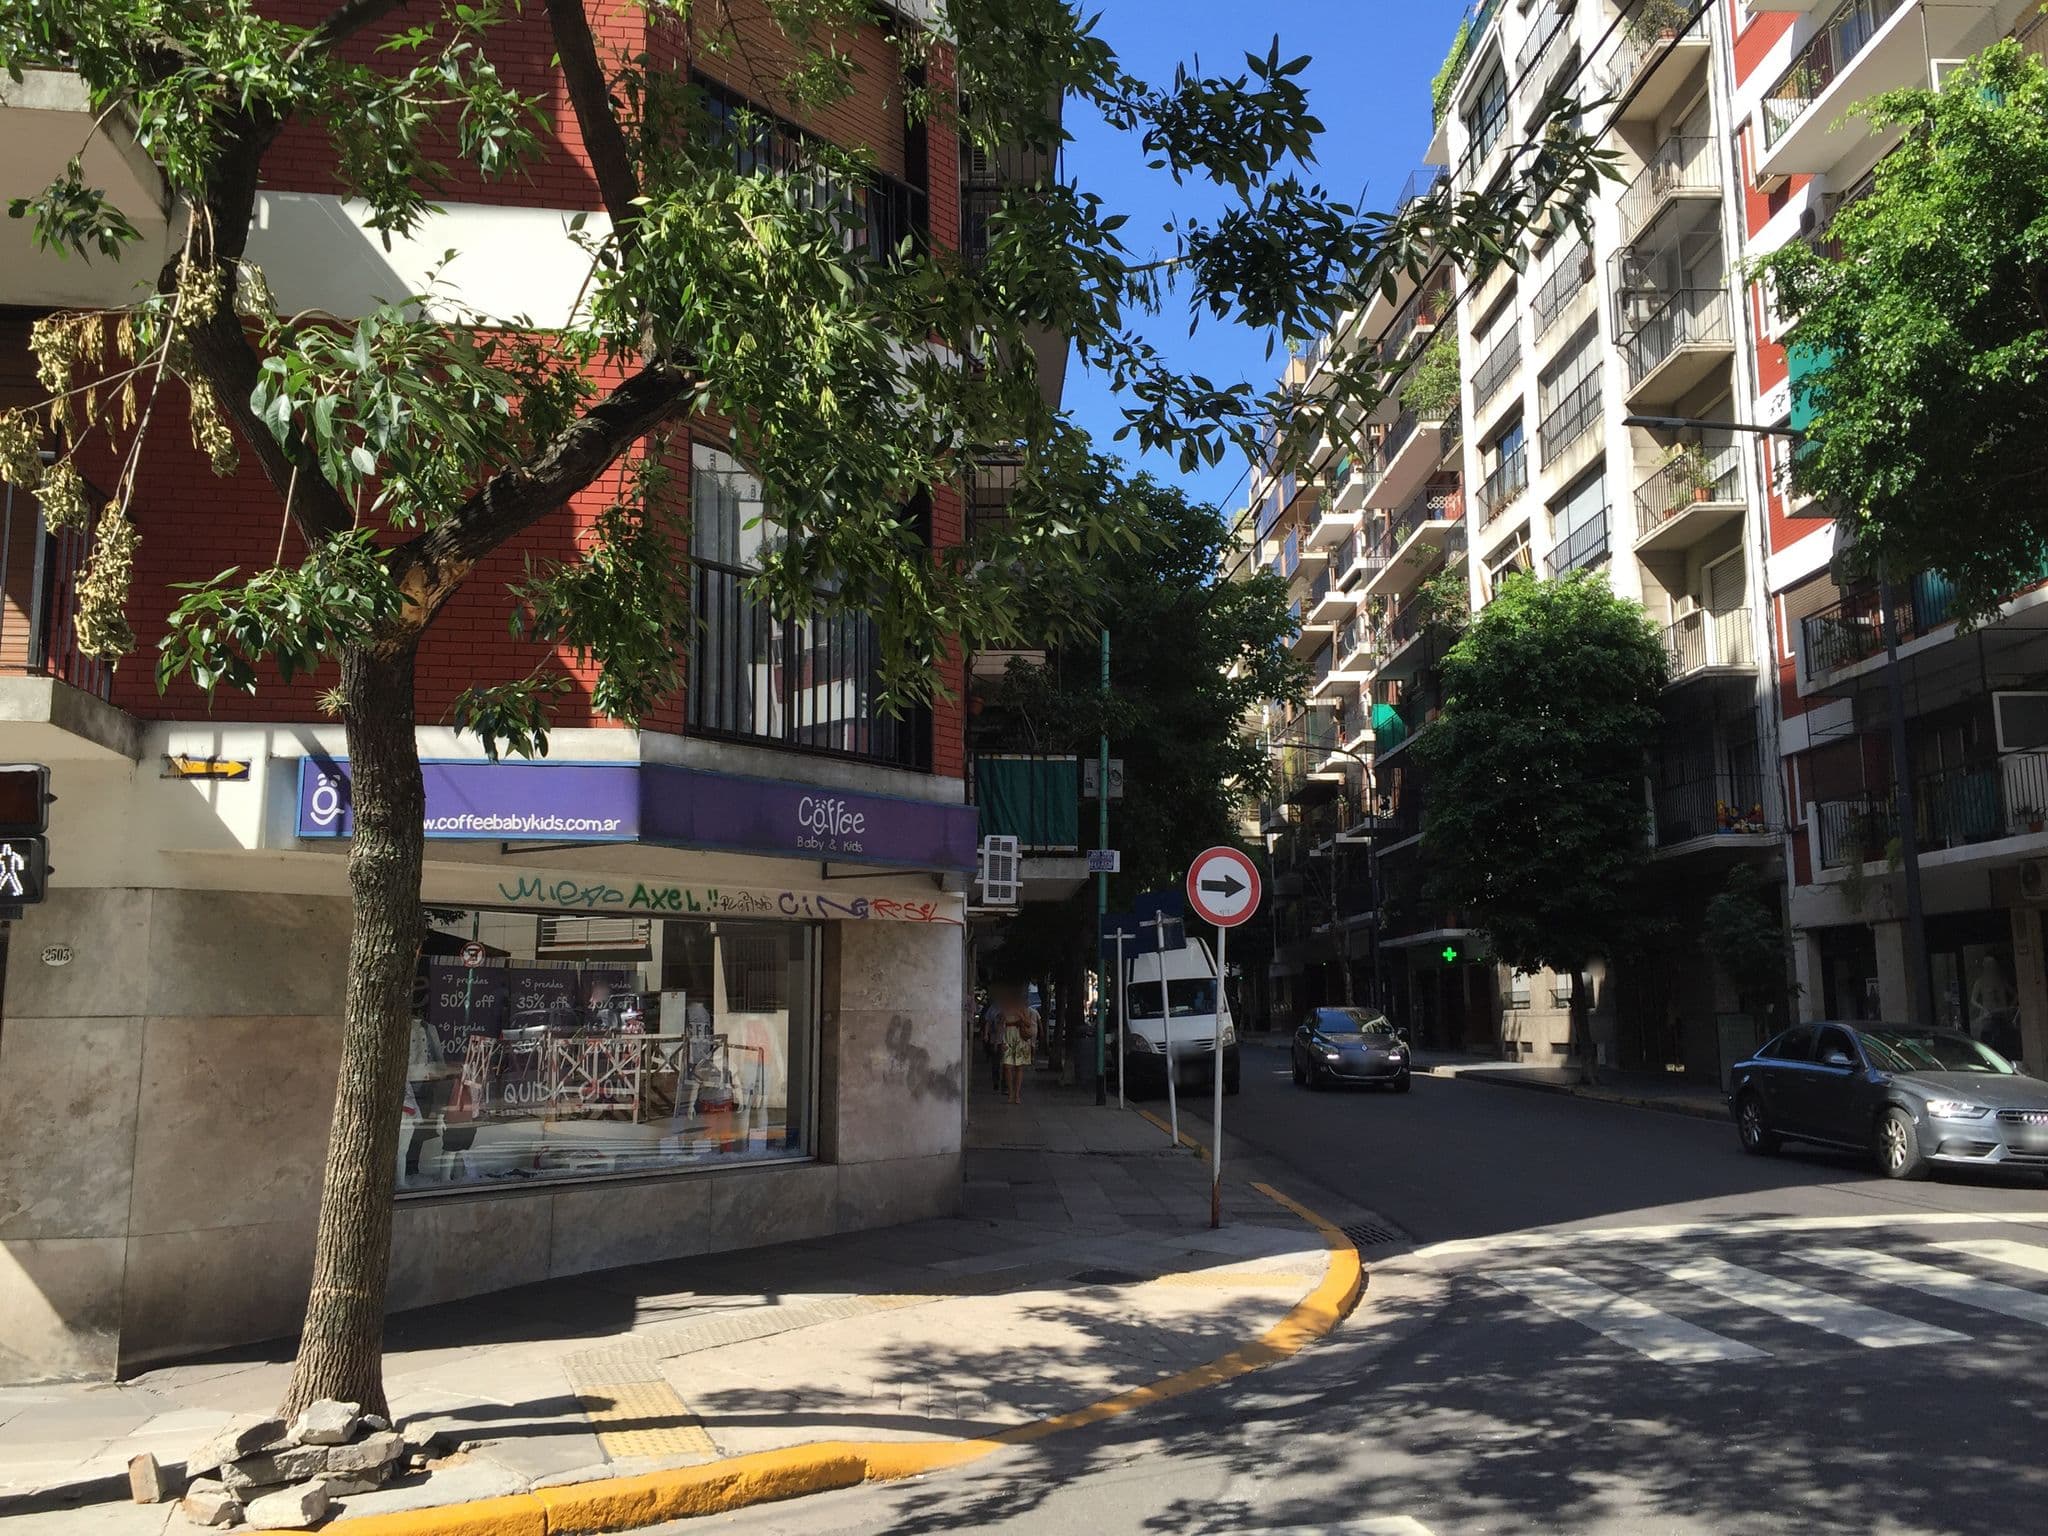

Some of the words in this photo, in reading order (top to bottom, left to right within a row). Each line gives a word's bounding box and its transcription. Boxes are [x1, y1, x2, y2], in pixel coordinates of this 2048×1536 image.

[423, 813, 621, 832] w.coffeebabykids.com.ar
[798, 796, 865, 836] Coffee
[797, 836, 824, 851] Baby
[828, 839, 837, 851] &
[843, 841, 864, 853] Kids
[45, 948, 70, 962] 2503
[440, 991, 470, 1008] 50%
[475, 994, 495, 1008] off
[516, 993, 546, 1009] 35%
[484, 1078, 630, 1105] IQUIDACION
